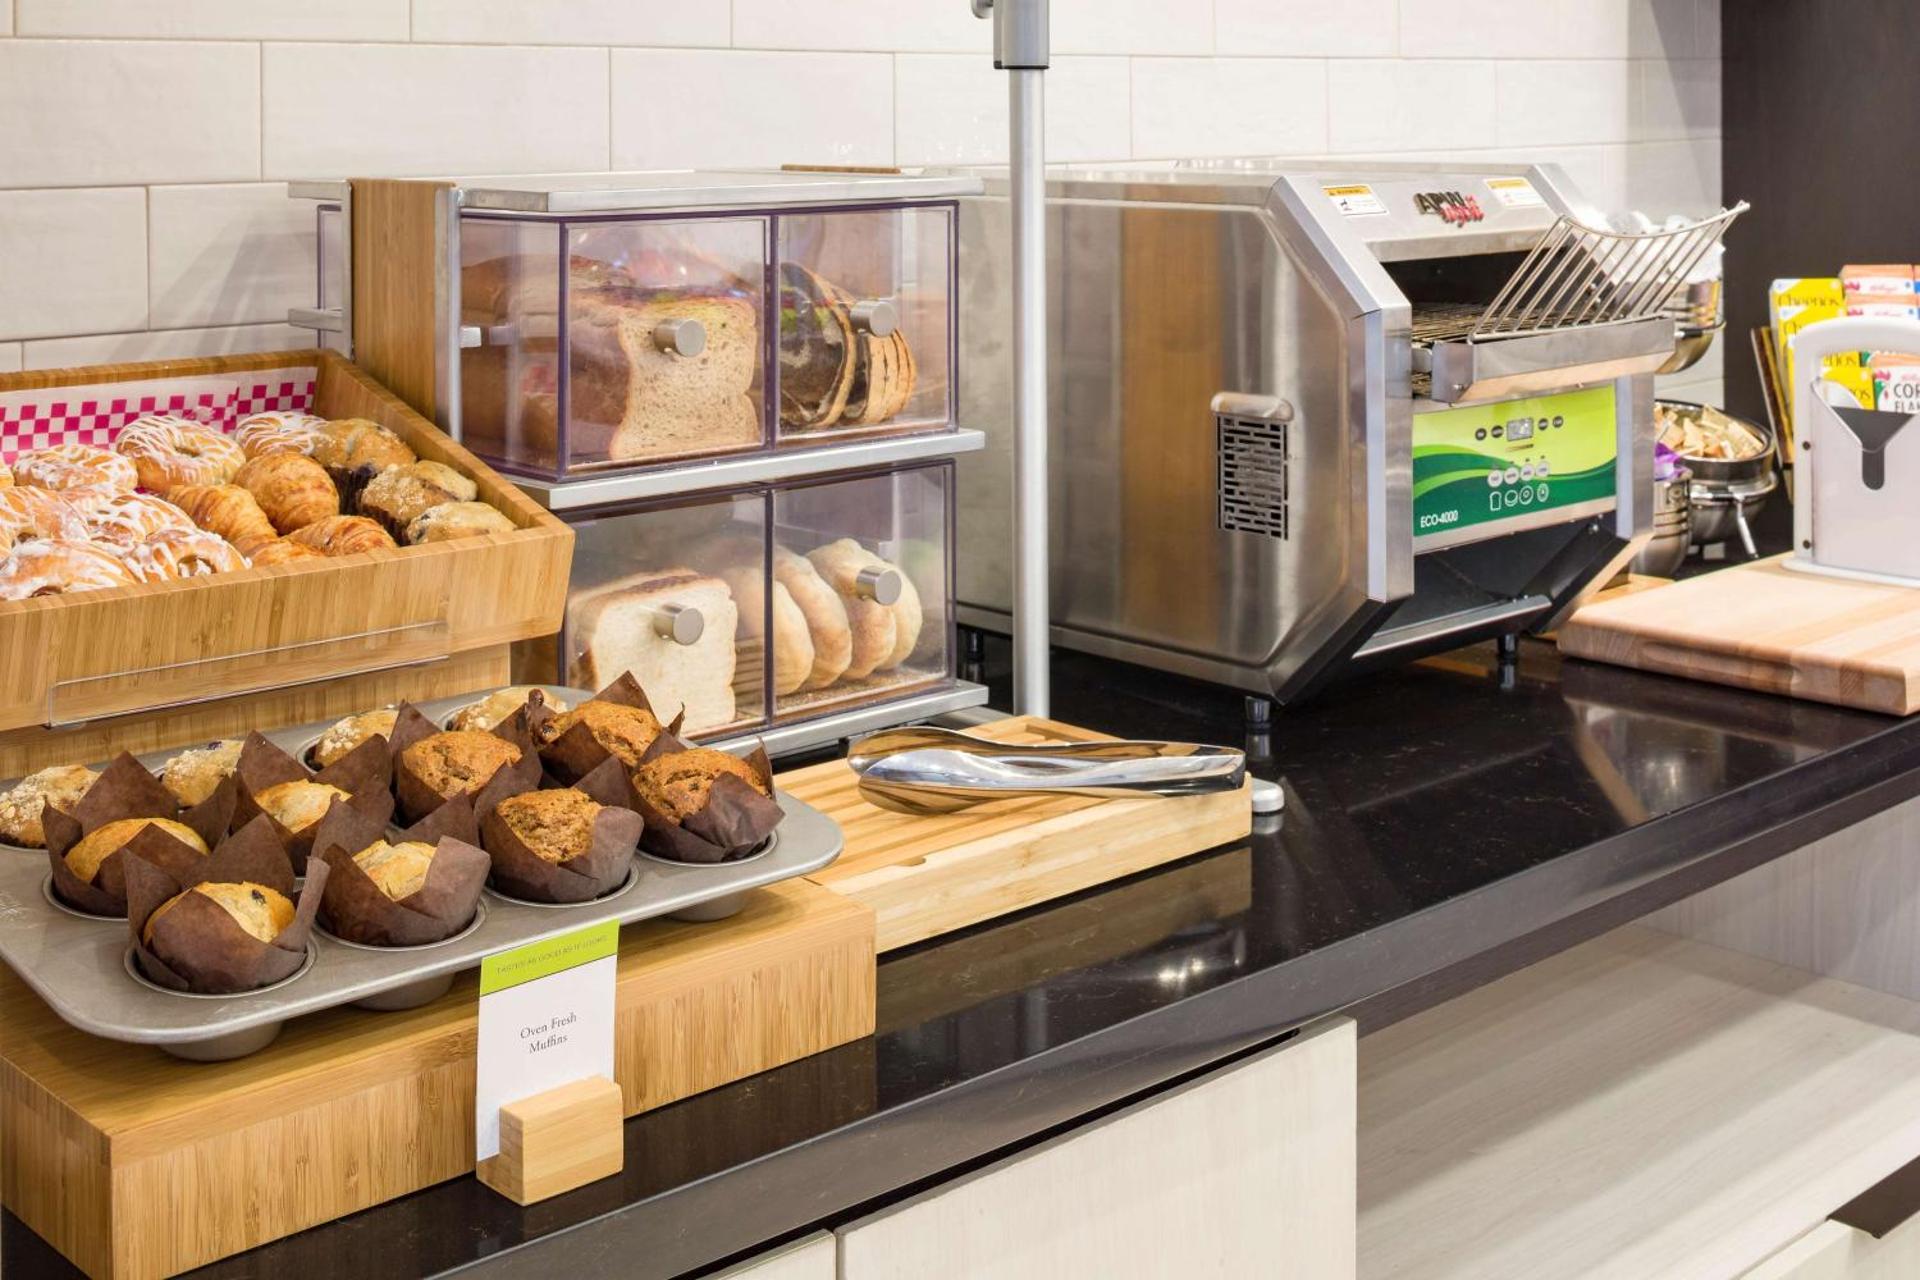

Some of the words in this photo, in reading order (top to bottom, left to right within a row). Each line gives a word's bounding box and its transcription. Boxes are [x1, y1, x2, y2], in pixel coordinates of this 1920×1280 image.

[1420, 509, 1459, 528] ECO-4000
[520, 1024, 548, 1039] Oven
[551, 1011, 577, 1029] Fresh
[529, 1034, 568, 1054] Muffins
